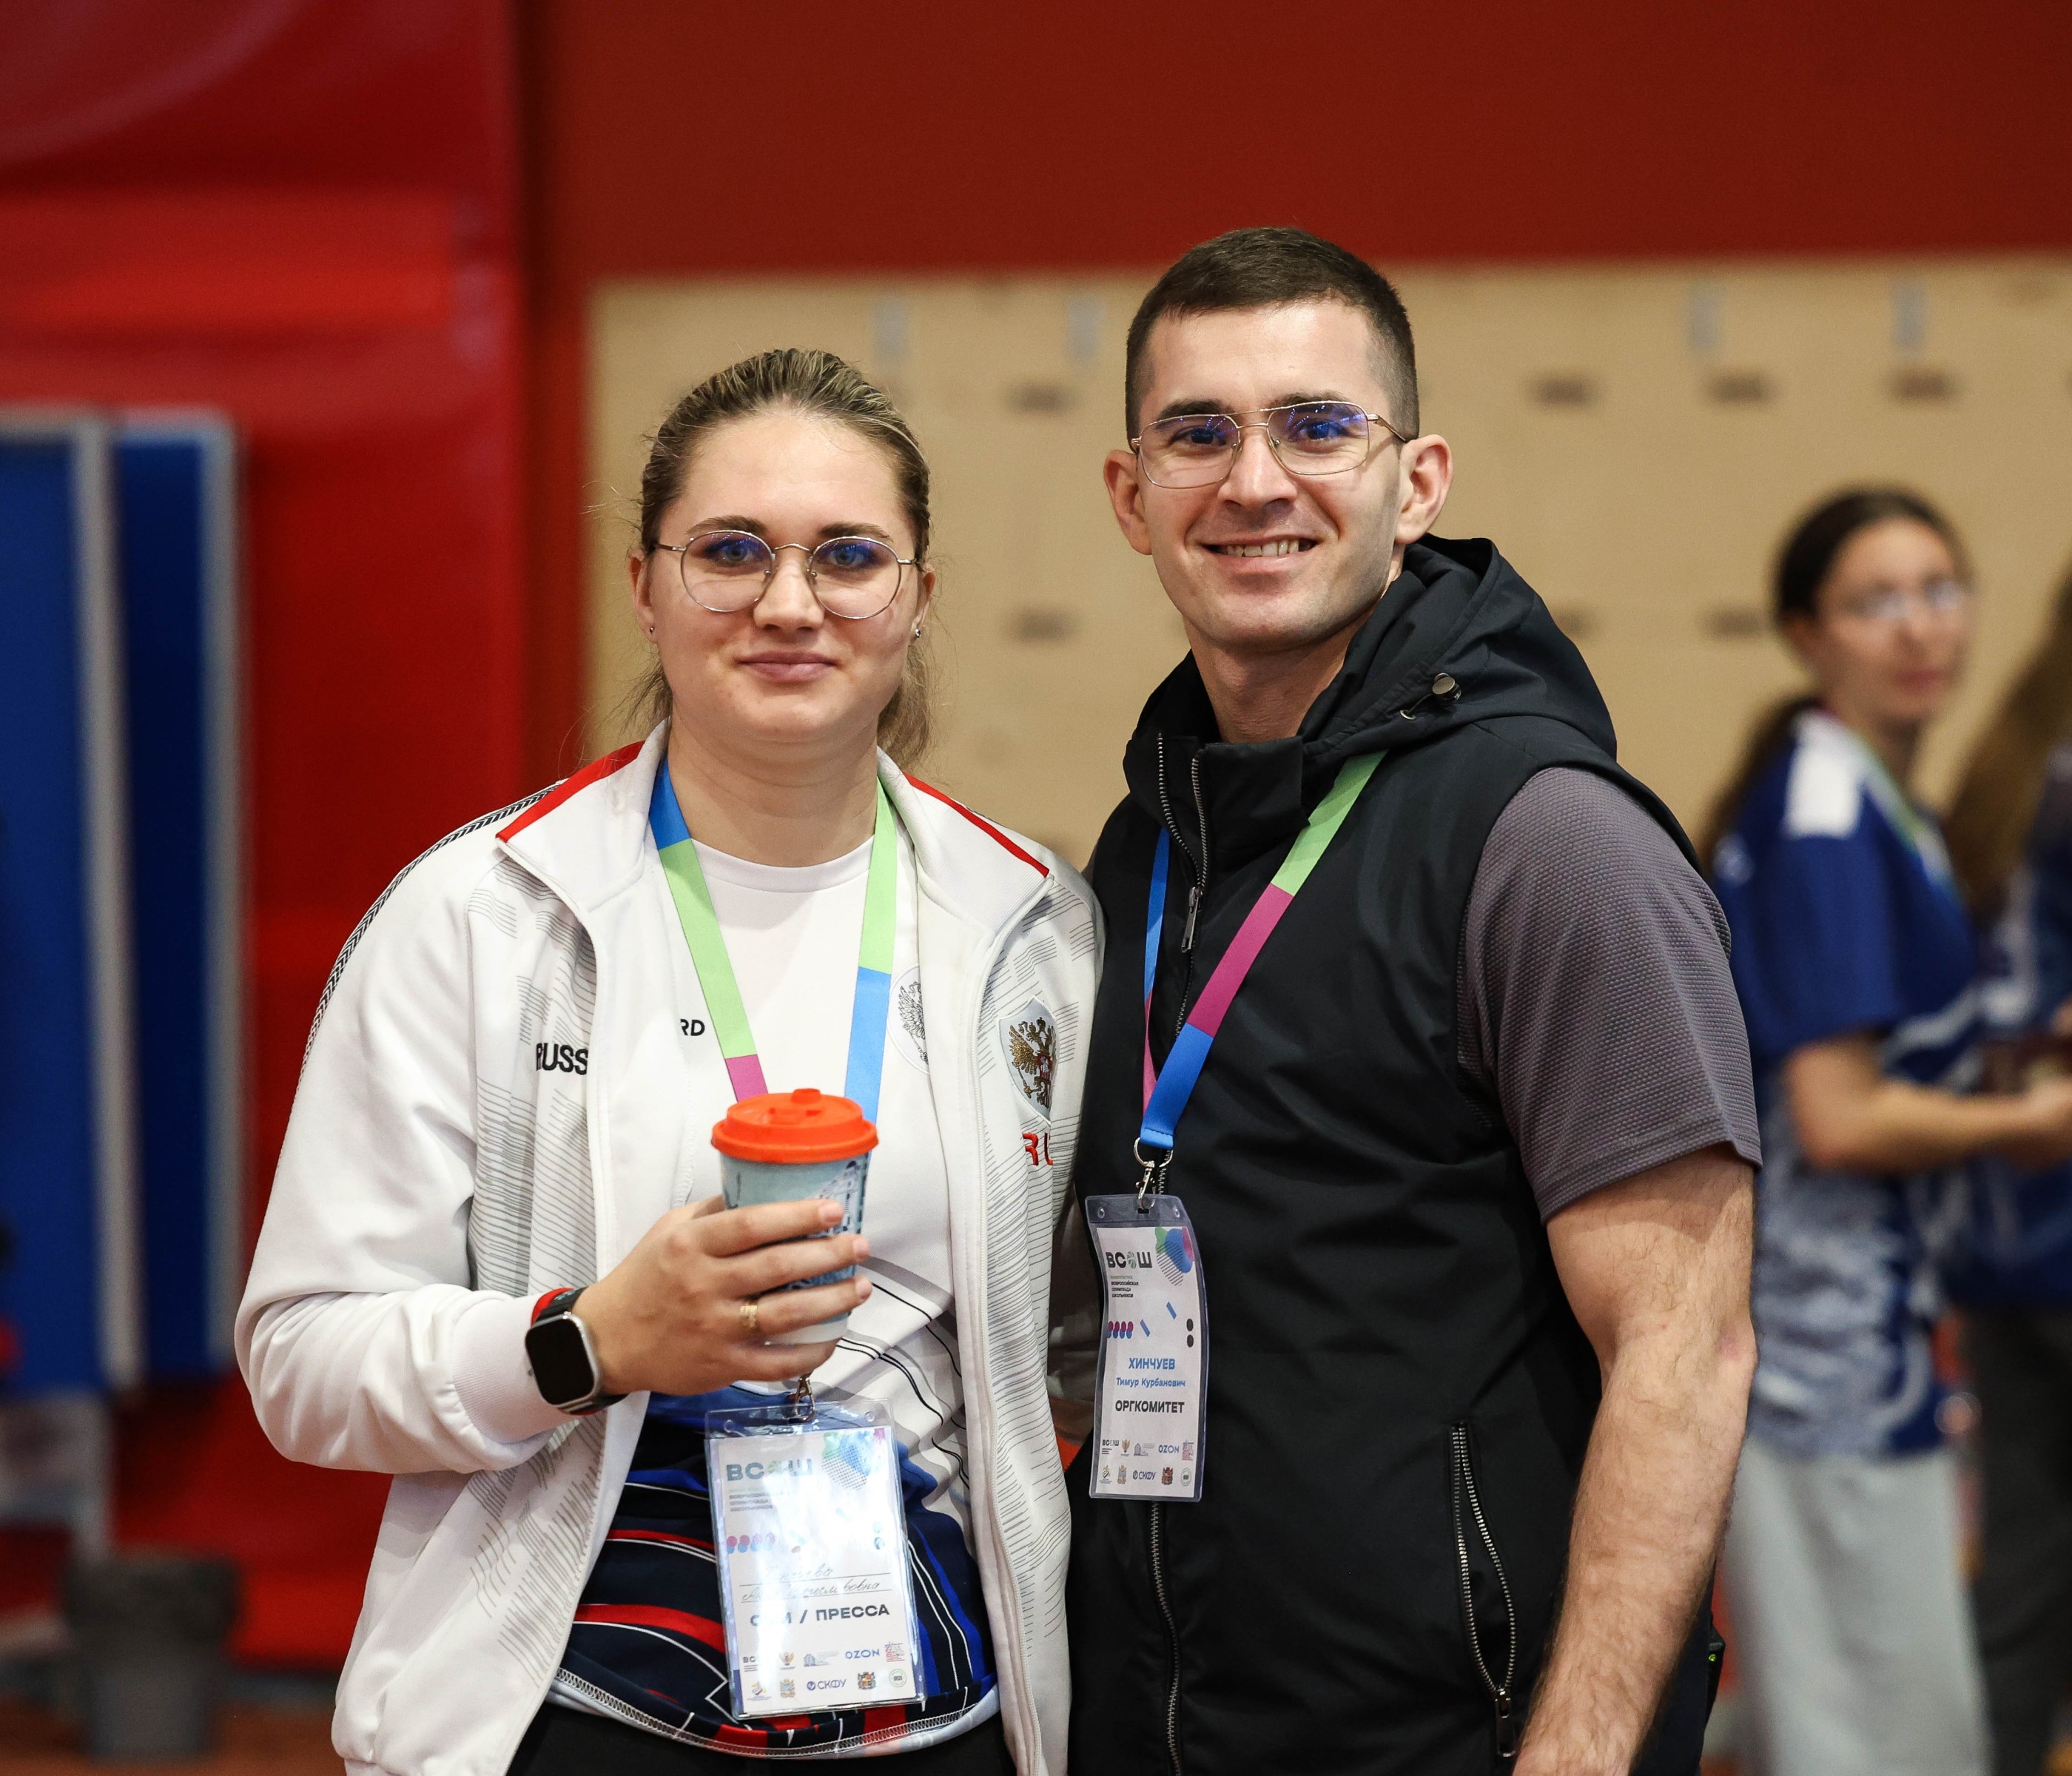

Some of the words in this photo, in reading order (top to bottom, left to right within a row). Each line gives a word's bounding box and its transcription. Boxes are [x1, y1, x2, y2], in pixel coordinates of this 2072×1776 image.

[1128, 1357, 1175, 1370] ХИНЧУЕВ
[1116, 1377, 1140, 1388] Тимур
[1141, 1377, 1185, 1389] Курбанович
[1115, 1399, 1185, 1413] ОРГКОМИТЕТ
[1157, 1444, 1180, 1454] OZON
[815, 1604, 890, 1621] ПРЕССА
[845, 1649, 880, 1660] OZON
[817, 1678, 847, 1690] СКФУ
